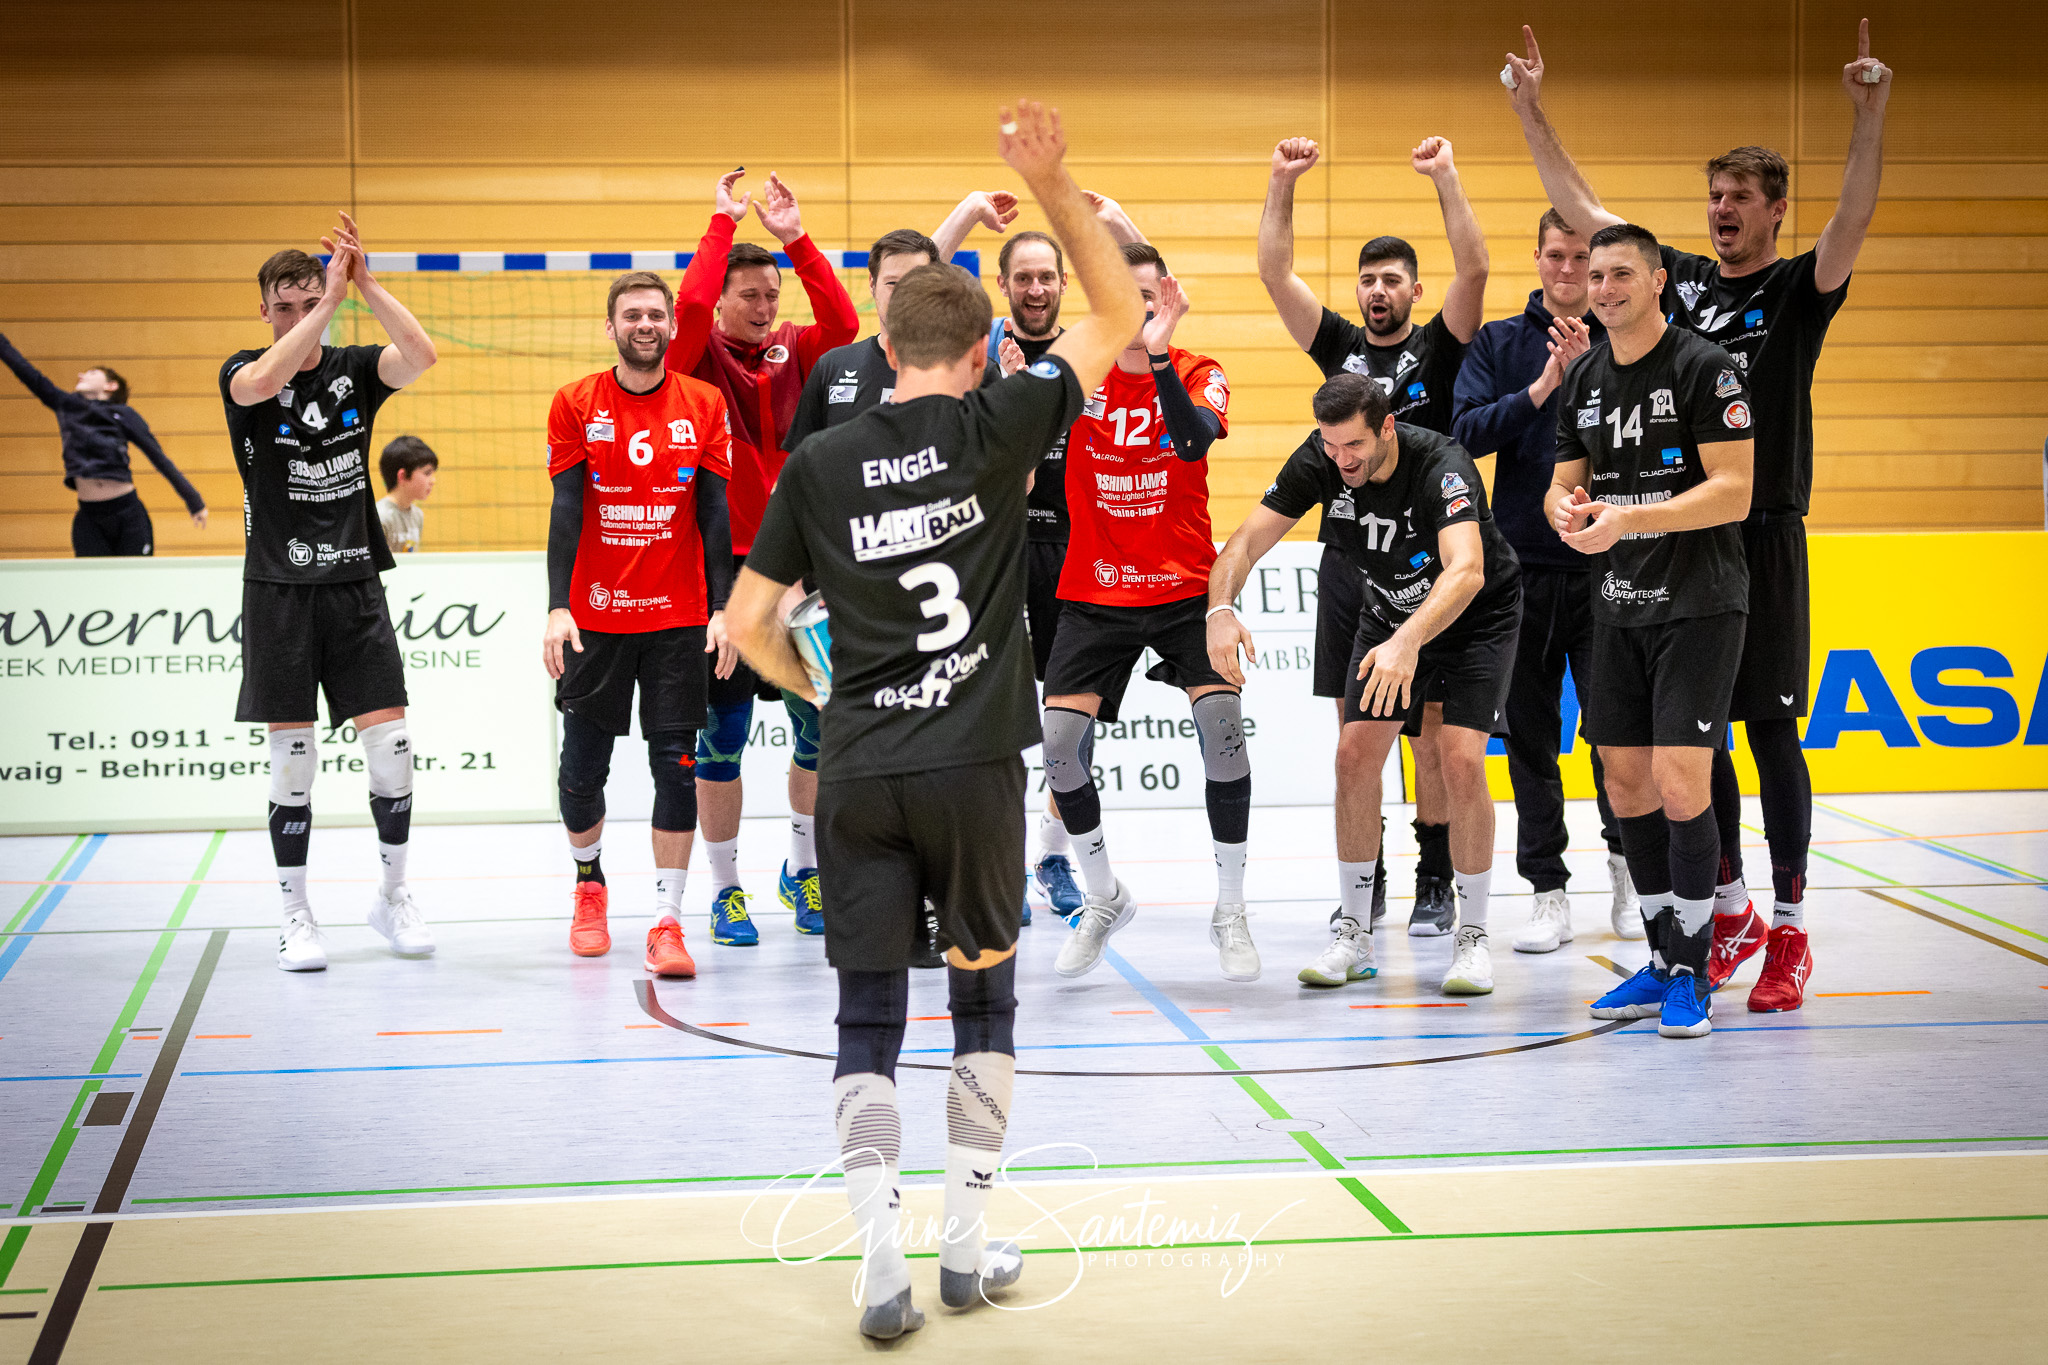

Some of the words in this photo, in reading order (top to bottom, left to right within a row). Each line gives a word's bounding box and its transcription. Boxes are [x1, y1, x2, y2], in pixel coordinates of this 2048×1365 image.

[301, 401, 329, 431] 4
[1107, 407, 1151, 447] 12
[1605, 404, 1644, 449] 14
[628, 429, 654, 466] 6
[326, 448, 362, 476] LAMPS
[862, 446, 948, 488] ENGEL
[607, 505, 645, 521] OSHINO
[646, 505, 676, 521] LAMP
[849, 505, 927, 551] HART
[929, 502, 976, 541] BAU
[1359, 512, 1397, 553] 17
[317, 543, 335, 552] VSL
[613, 589, 630, 599] VSL
[1389, 577, 1432, 601] LAMPS
[1615, 579, 1633, 590] VSL
[898, 561, 972, 652] 3
[48, 732, 117, 751] Tel.:
[131, 729, 210, 749] 0911
[460, 751, 497, 770] 21
[1140, 763, 1180, 790] 60
